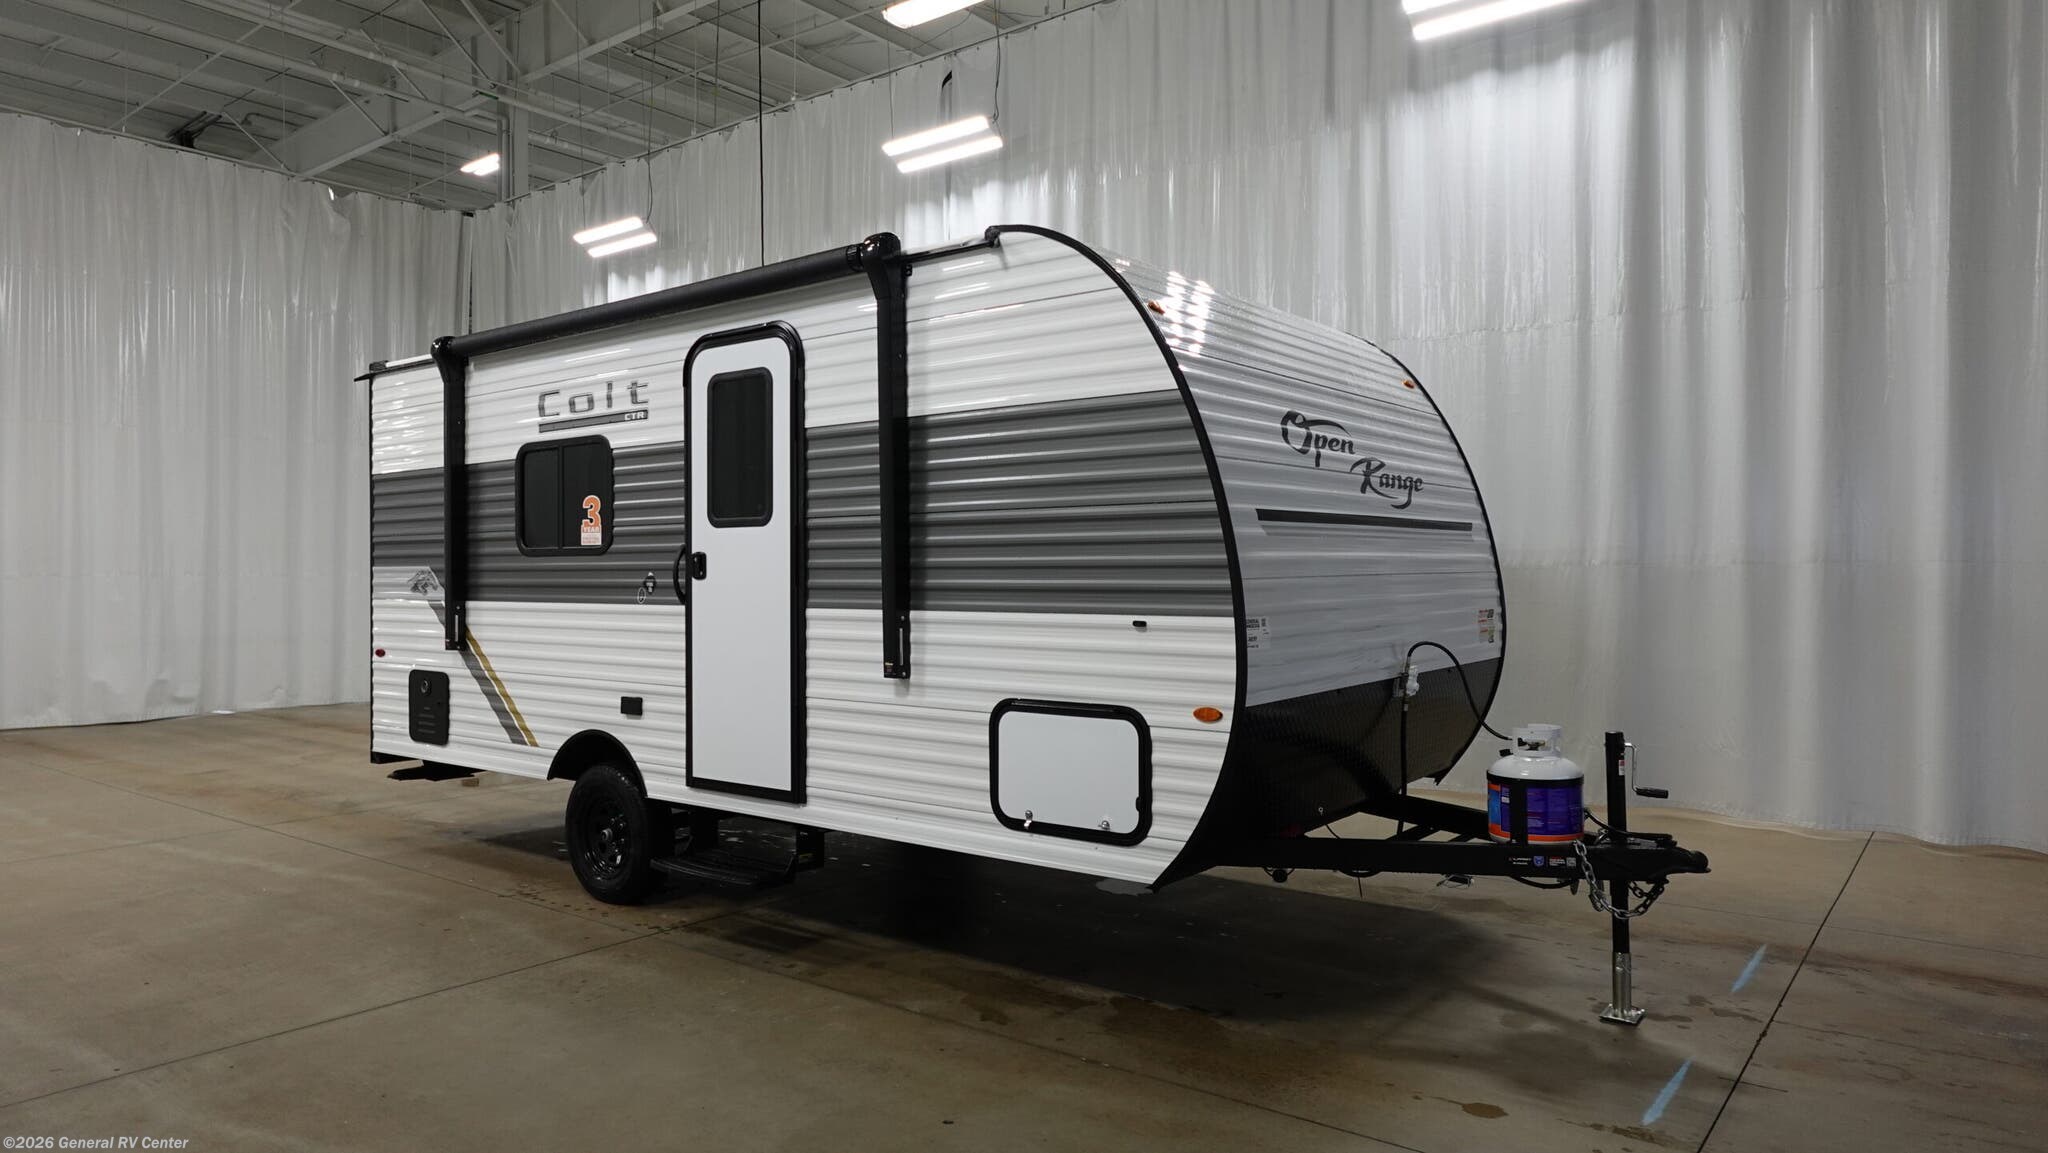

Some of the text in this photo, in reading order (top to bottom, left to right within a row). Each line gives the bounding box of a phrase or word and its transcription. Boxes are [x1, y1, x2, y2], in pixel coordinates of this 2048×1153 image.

[538, 382, 649, 417] Colt
[624, 411, 645, 421] CTR
[1280, 410, 1356, 468] Open
[1349, 457, 1424, 510] Range
[582, 495, 601, 527] 3
